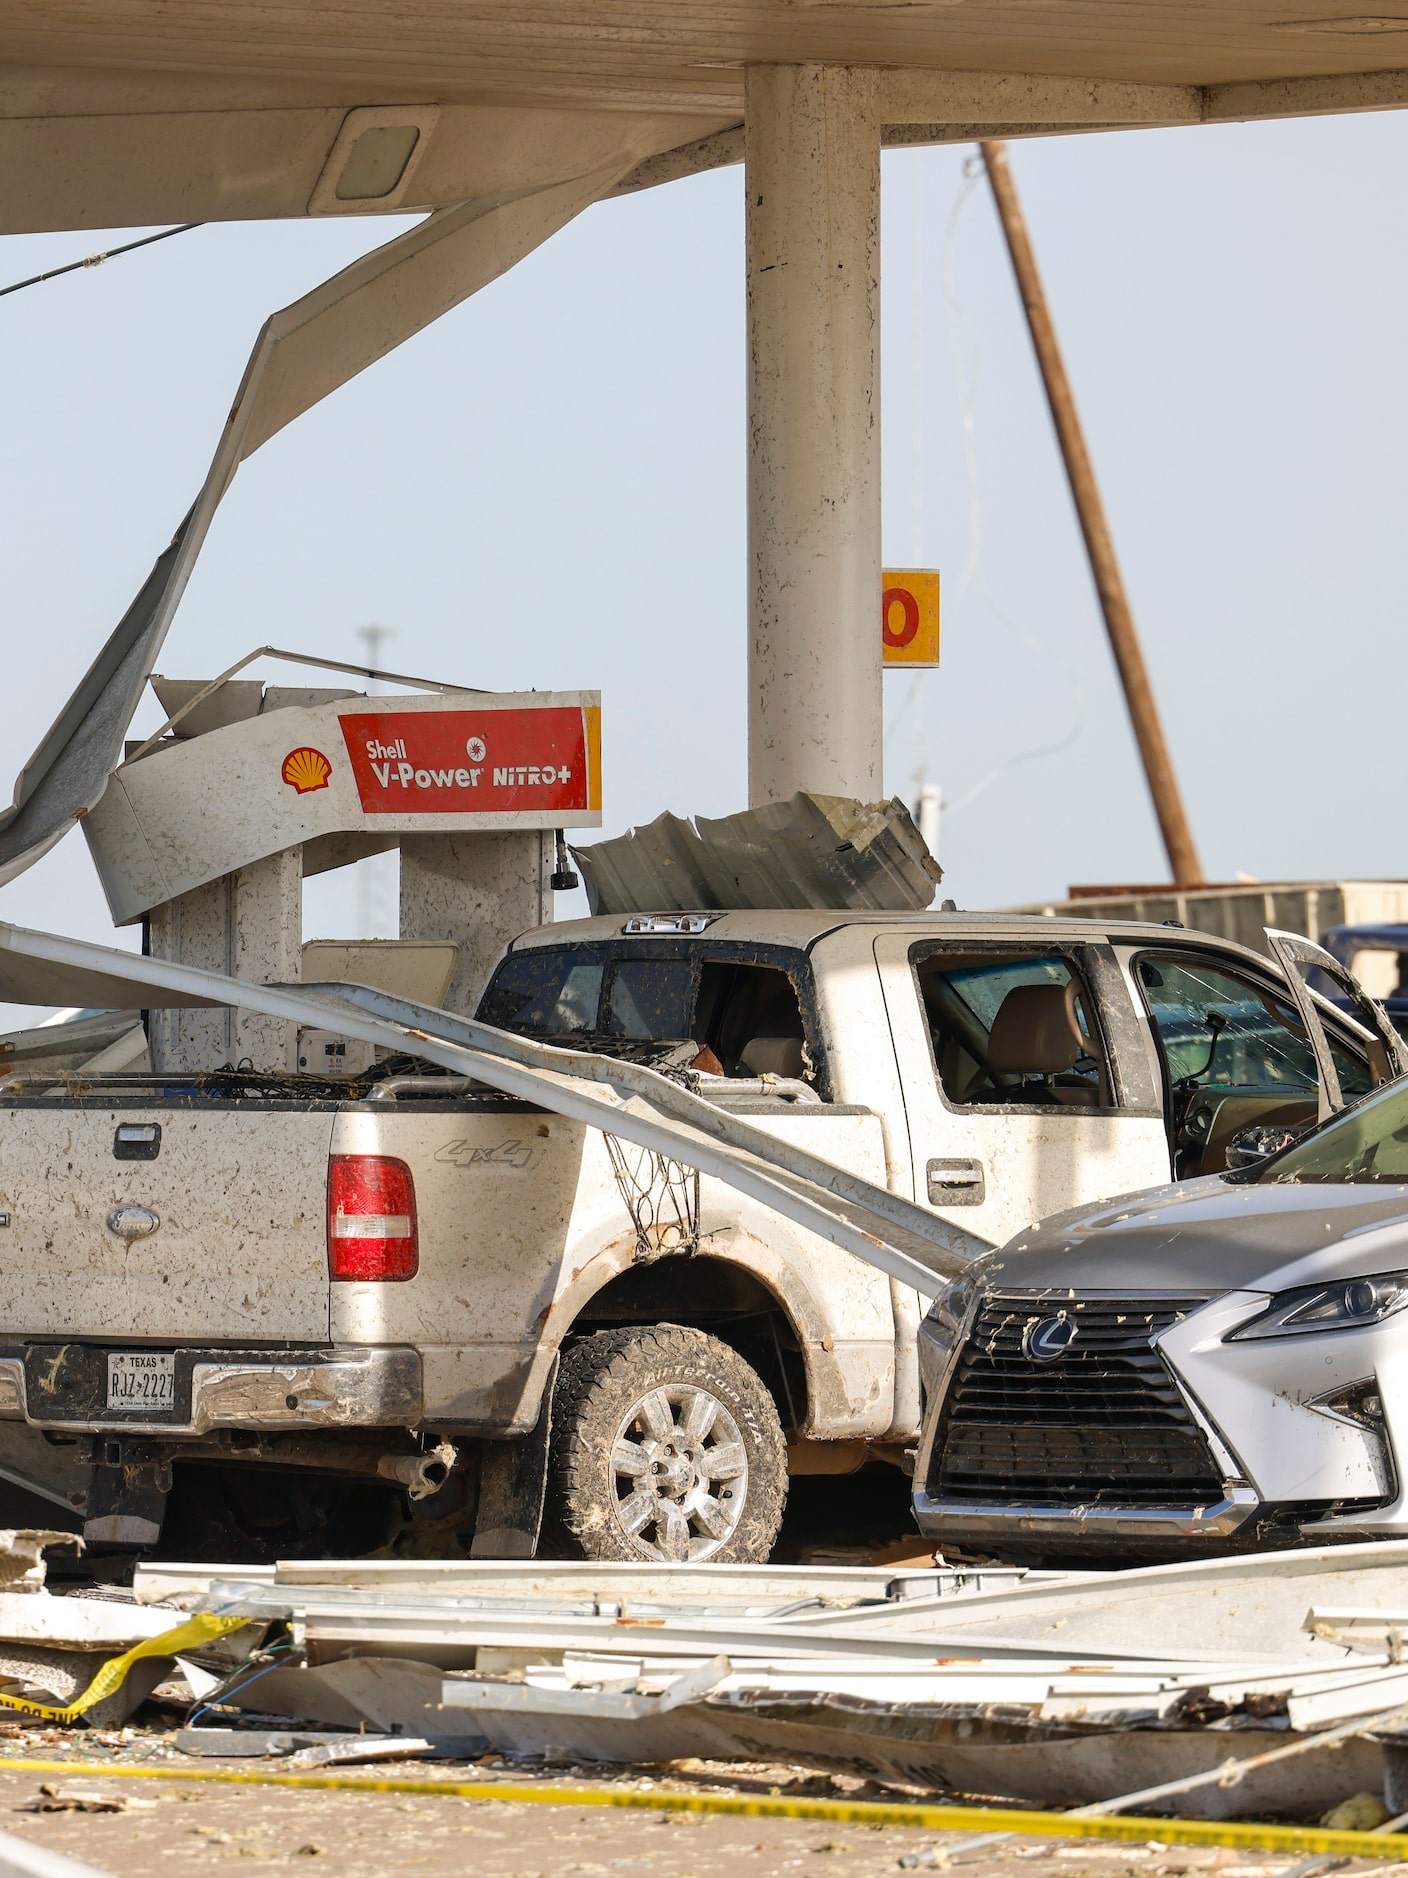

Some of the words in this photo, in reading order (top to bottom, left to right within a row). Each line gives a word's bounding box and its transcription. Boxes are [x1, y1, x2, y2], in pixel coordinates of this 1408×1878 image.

[366, 739, 407, 760] Shell
[370, 762, 482, 789] V-Power
[434, 1140, 533, 1168] 4x4
[130, 1357, 157, 1368] TEXAS
